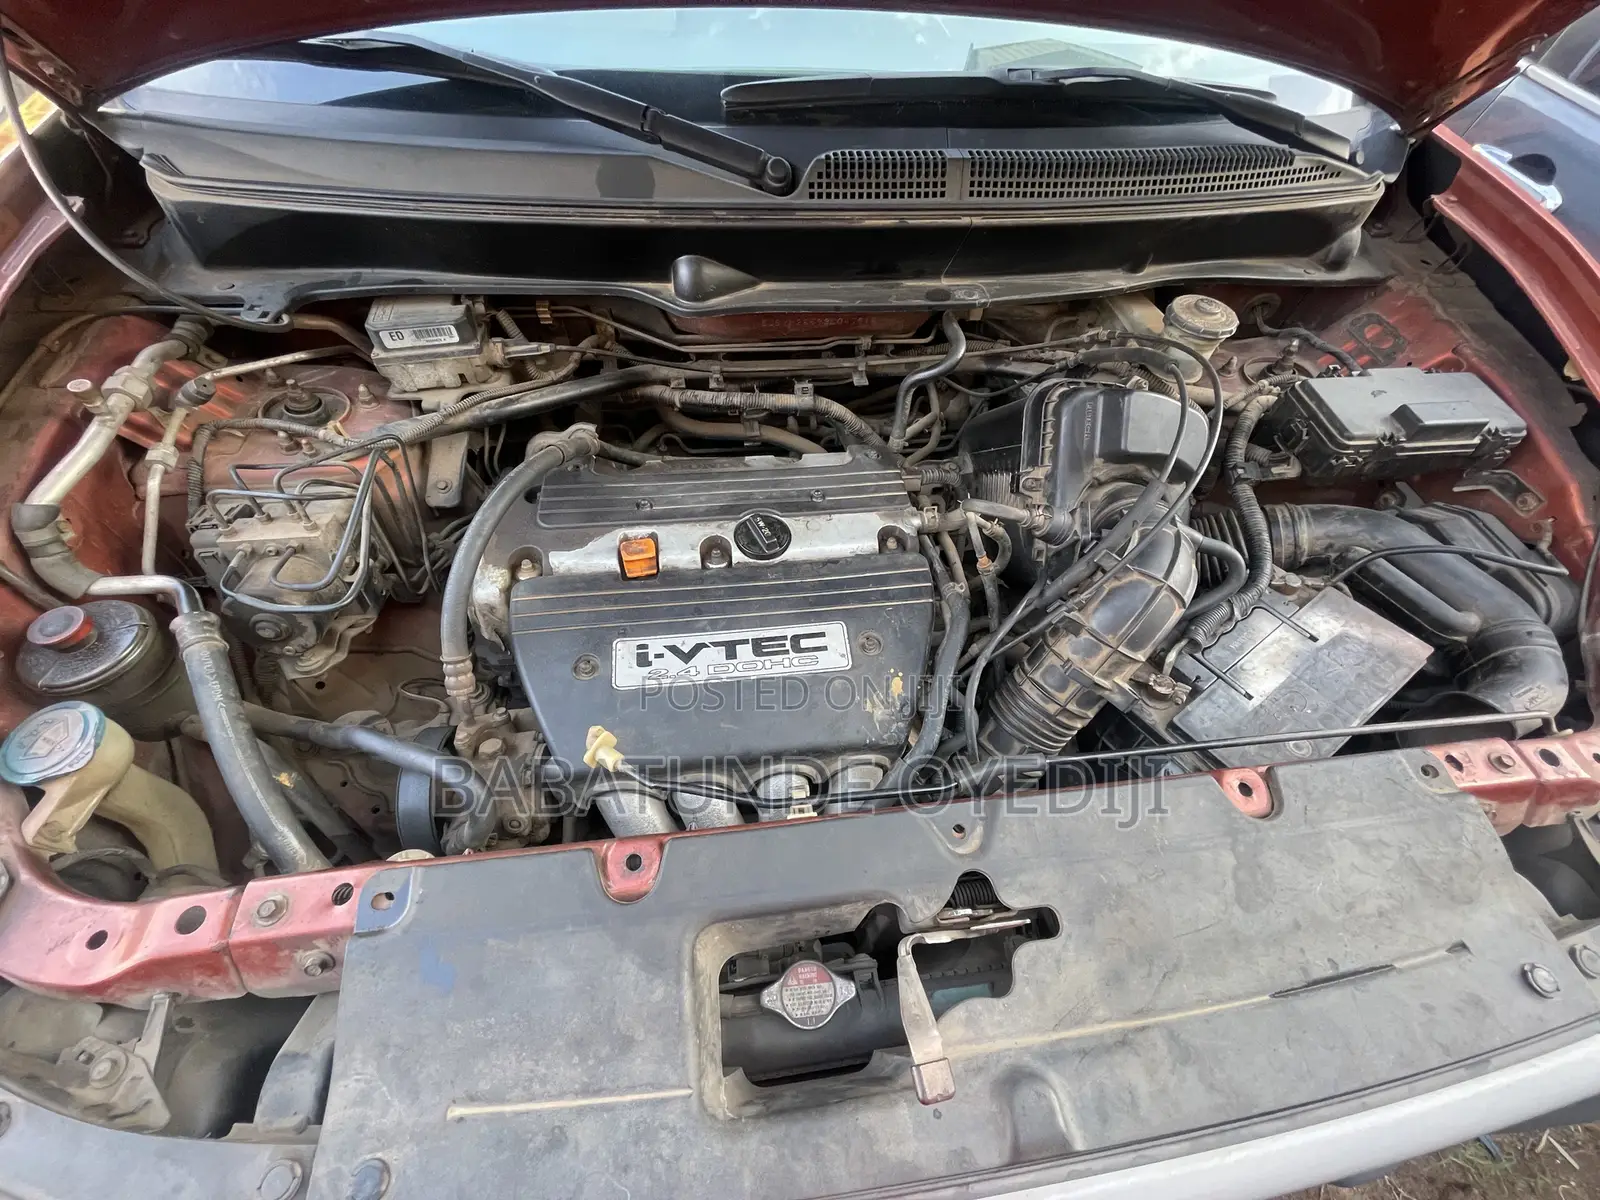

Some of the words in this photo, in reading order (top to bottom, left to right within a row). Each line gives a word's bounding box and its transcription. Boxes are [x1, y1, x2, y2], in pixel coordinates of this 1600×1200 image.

[388, 331, 405, 341] ED
[754, 516, 772, 537] 5W-20
[635, 631, 829, 668] i-VTEC
[647, 666, 701, 681] 2.4
[707, 655, 820, 676] DOHC
